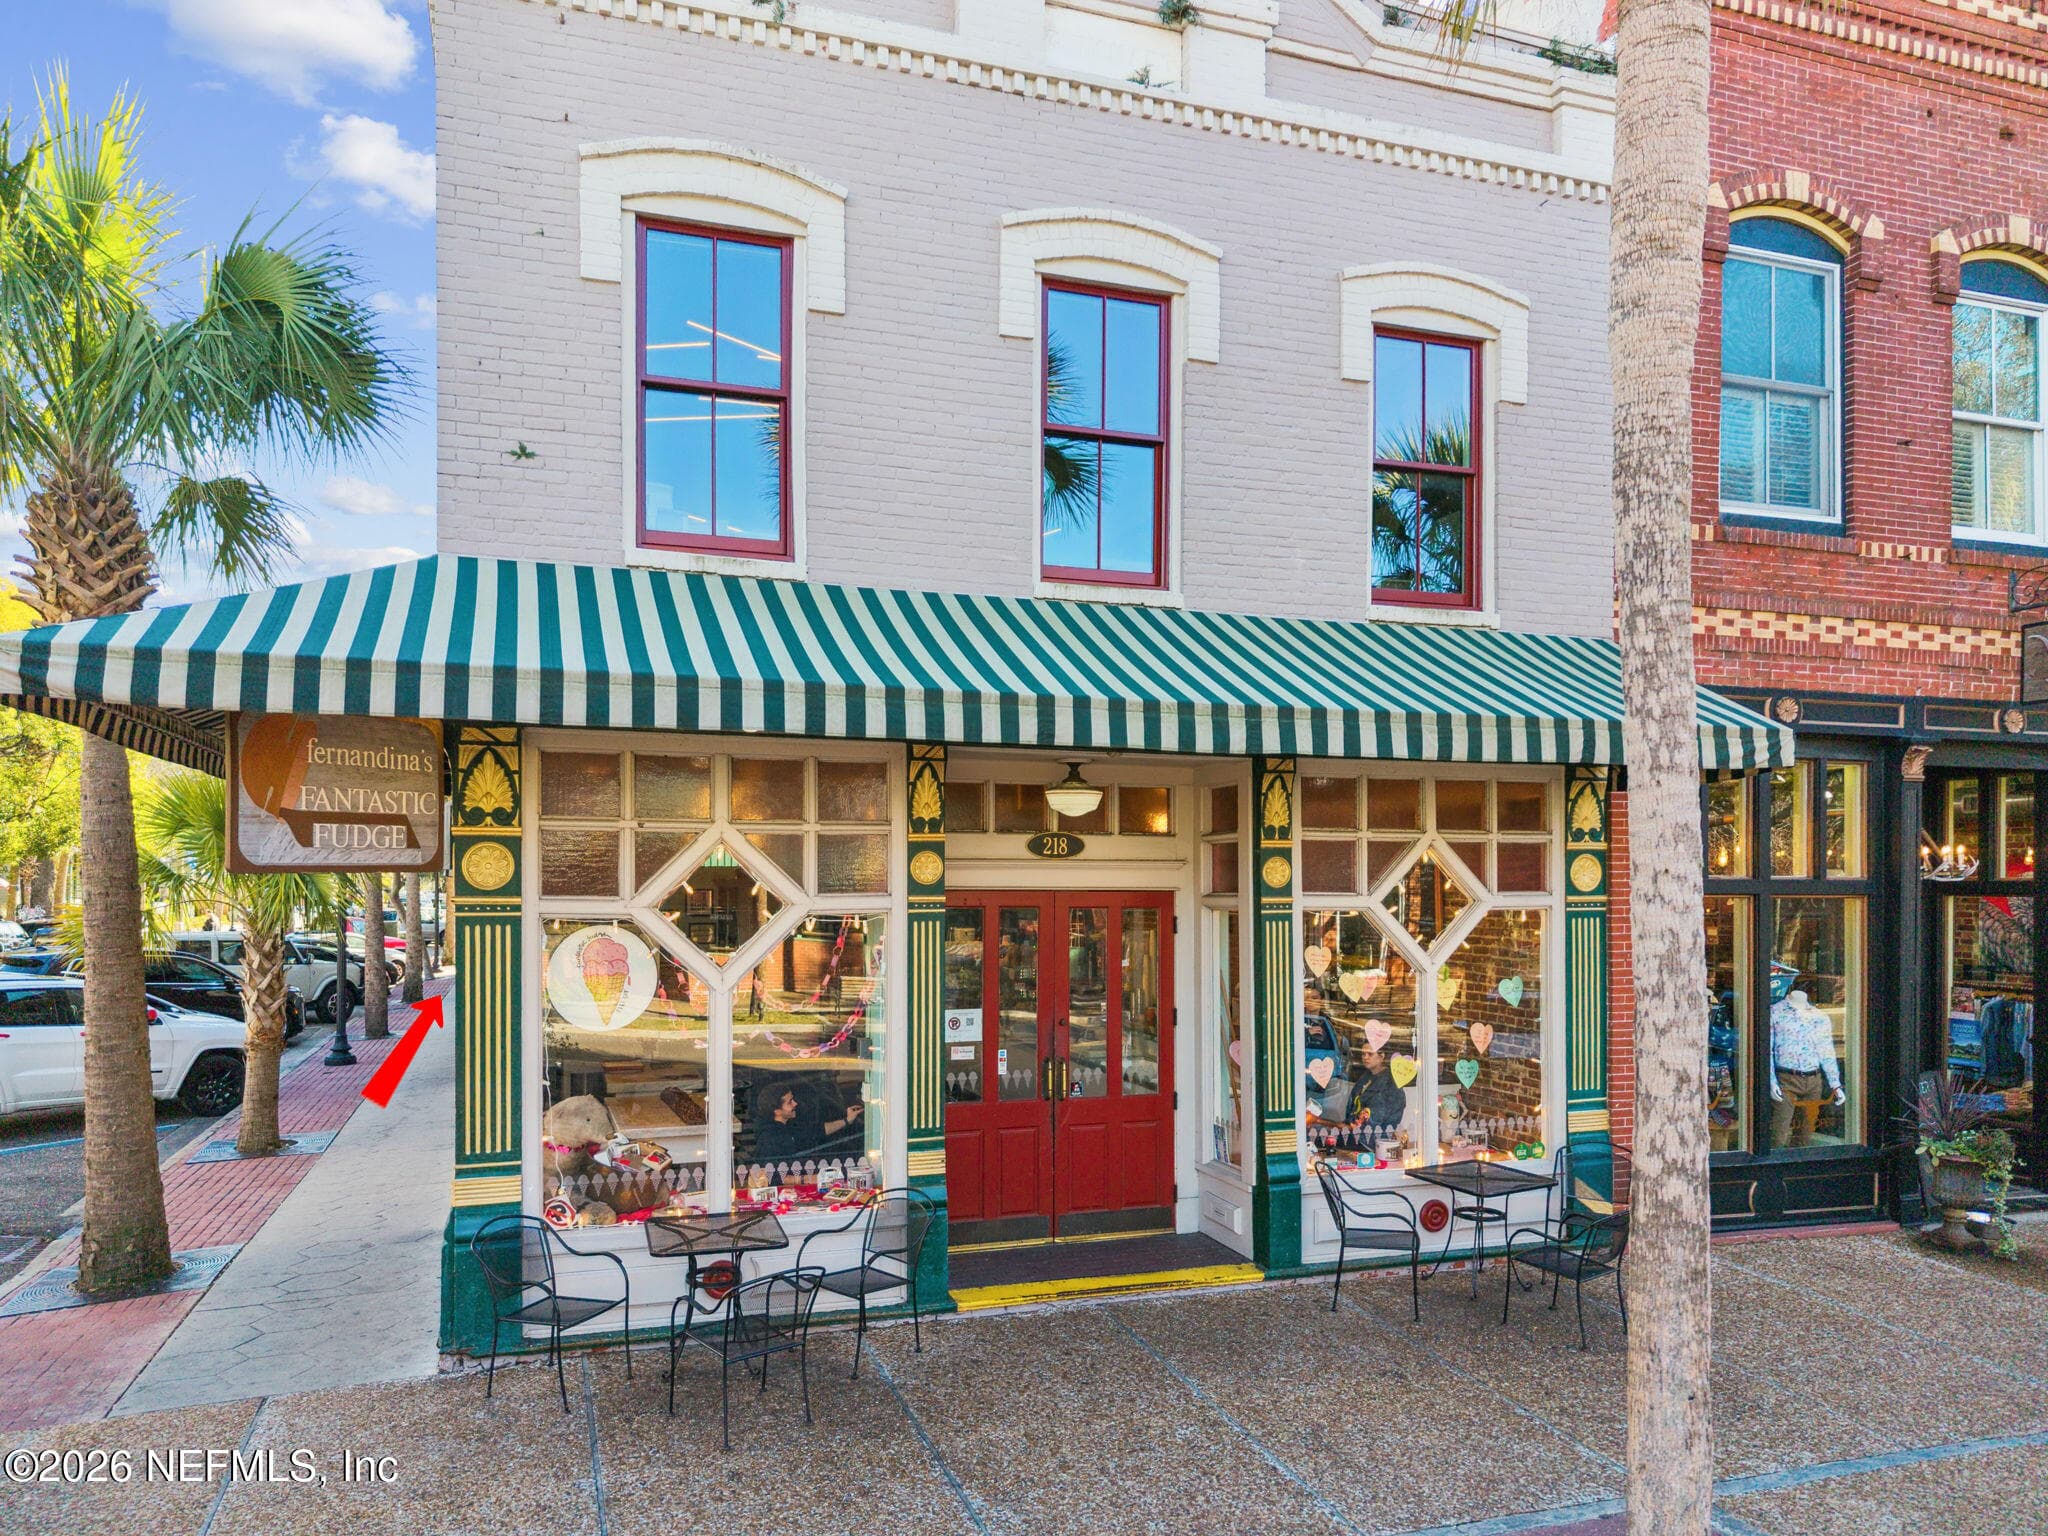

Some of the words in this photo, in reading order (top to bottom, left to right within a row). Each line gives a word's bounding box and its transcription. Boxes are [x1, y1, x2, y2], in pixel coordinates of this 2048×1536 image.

[306, 737, 433, 773] fernandina's
[299, 785, 437, 815] FANTASTIC
[313, 822, 408, 849] FUDGE
[1043, 836, 1068, 855] 218
